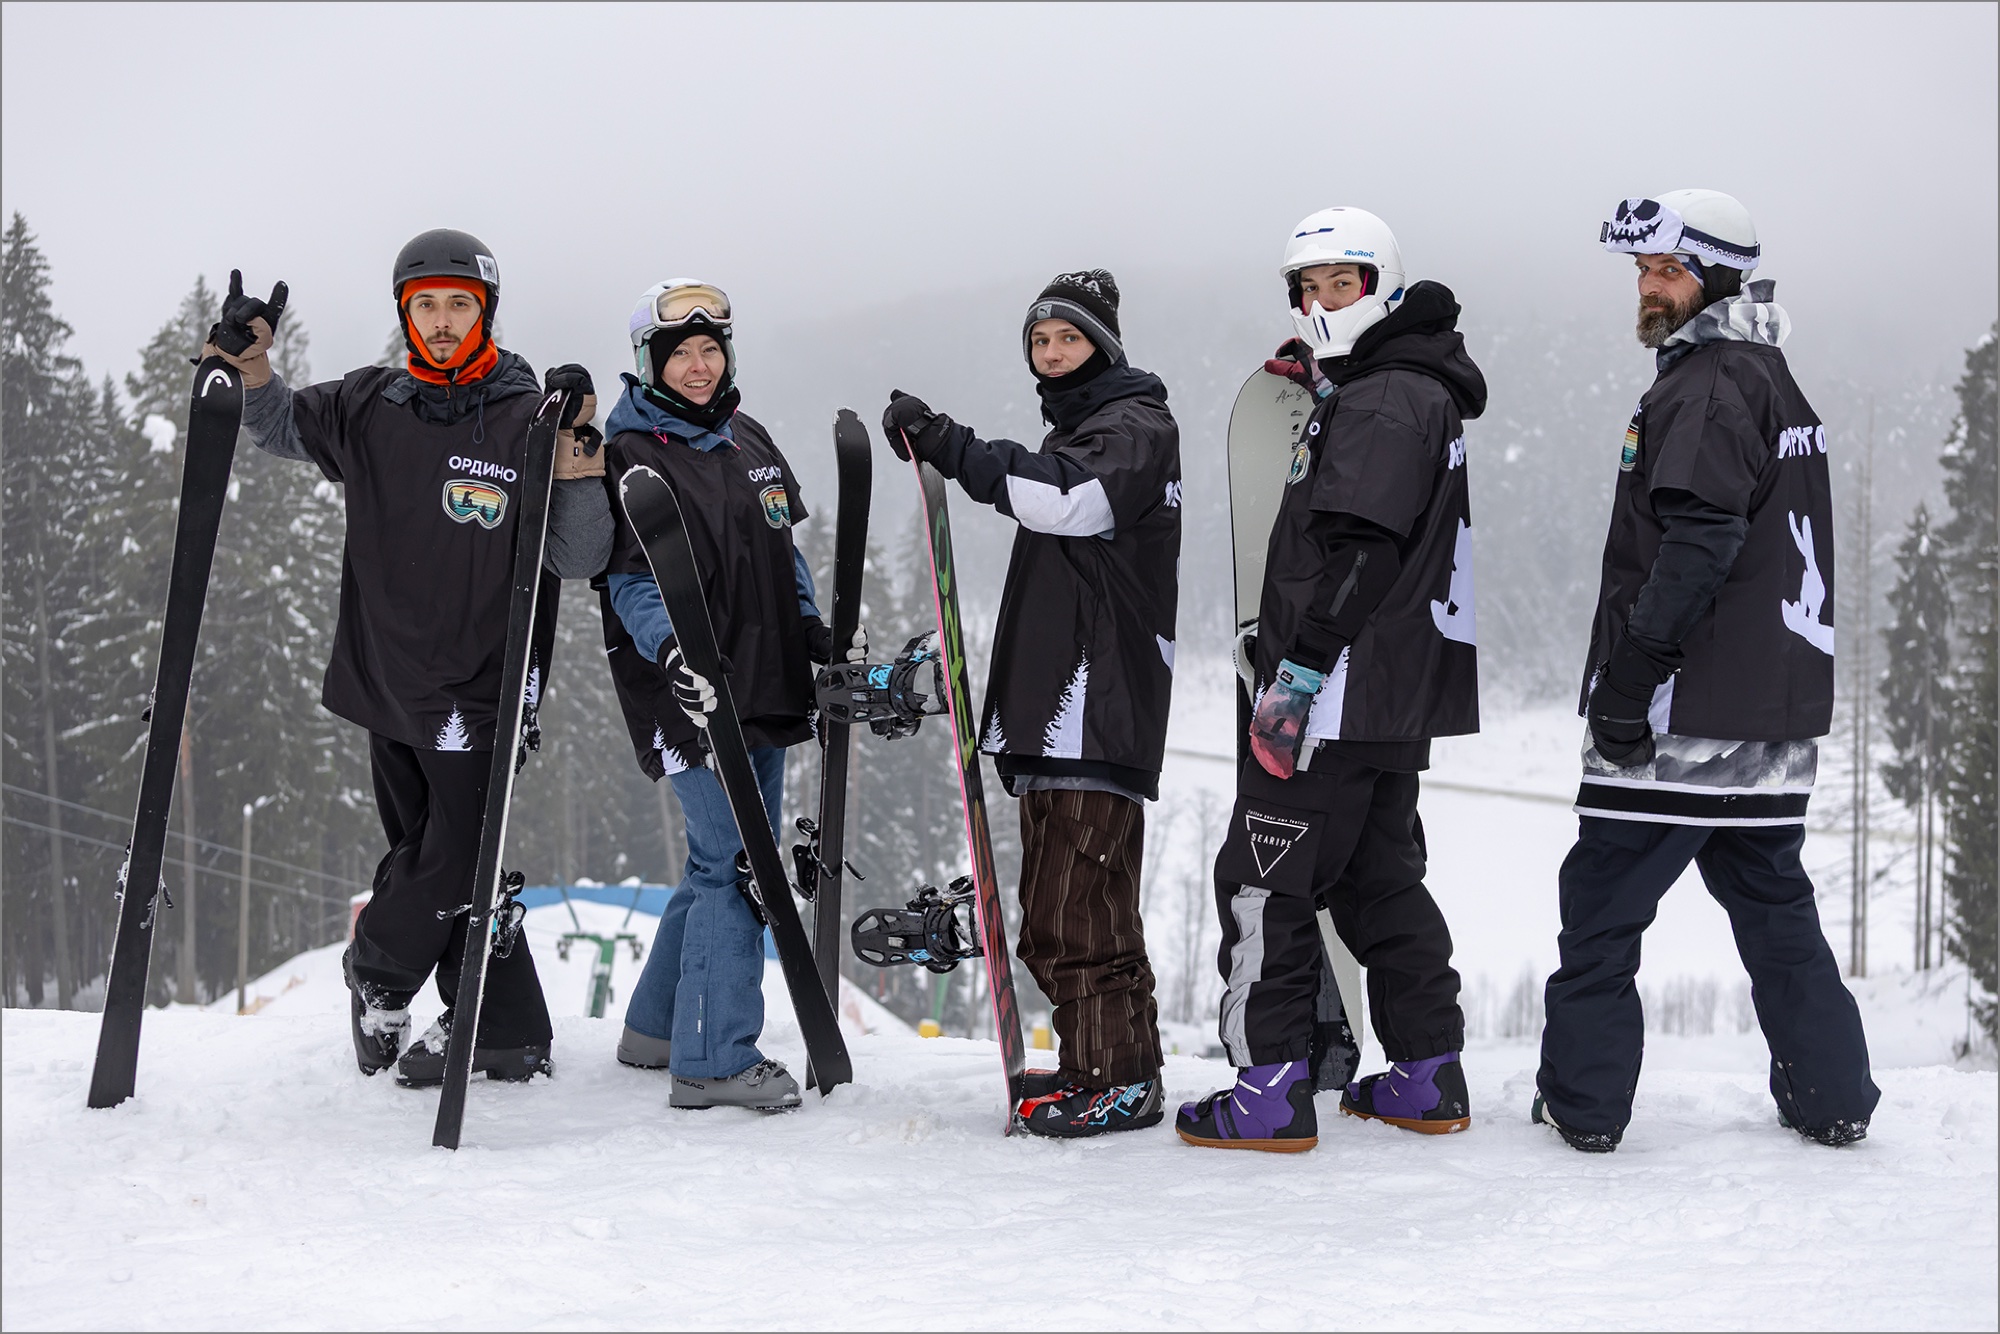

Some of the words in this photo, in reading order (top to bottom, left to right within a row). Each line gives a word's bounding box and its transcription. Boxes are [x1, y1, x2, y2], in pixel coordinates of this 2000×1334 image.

[1696, 240, 1715, 252] LOS
[448, 455, 517, 483] ОРДИНО
[1250, 832, 1293, 850] SEARIPE
[676, 1078, 705, 1091] HEAD
